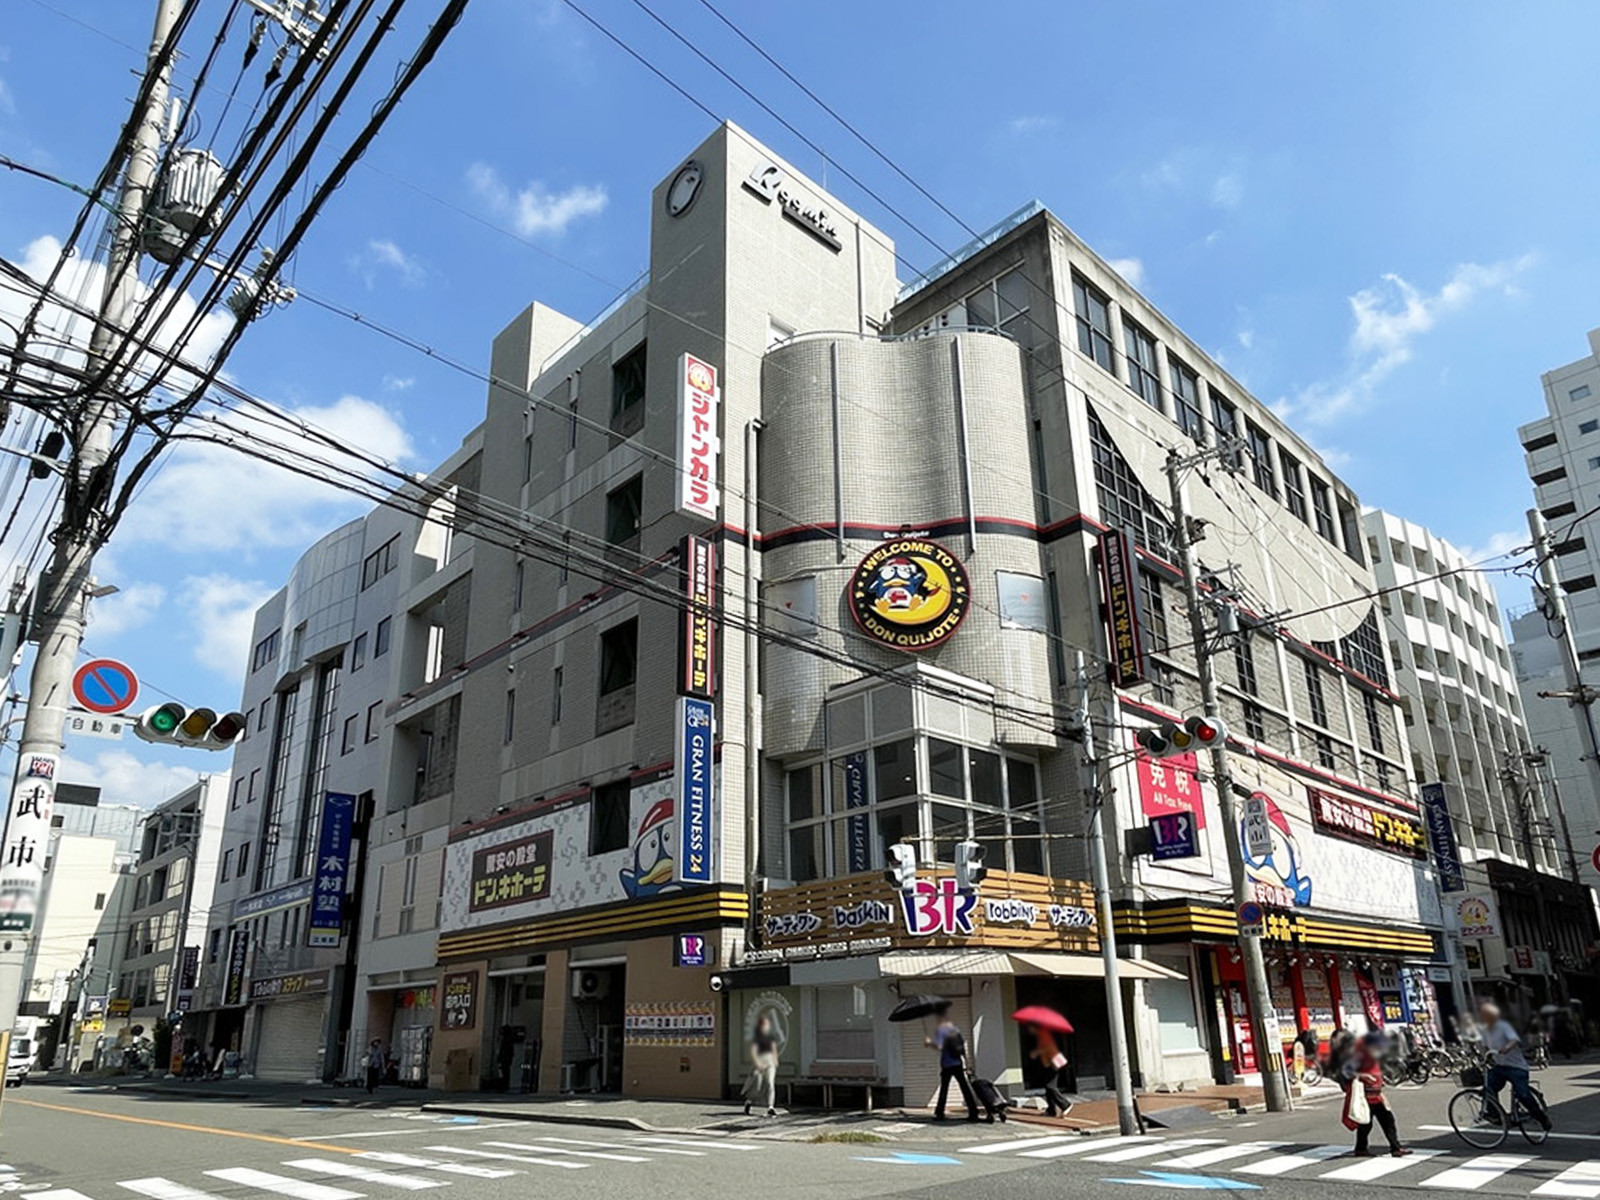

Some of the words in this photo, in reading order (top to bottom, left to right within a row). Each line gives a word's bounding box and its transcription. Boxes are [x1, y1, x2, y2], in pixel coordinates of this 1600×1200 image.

[690, 392, 709, 504] ジャンカラ
[863, 541, 935, 571] WELCOME
[935, 549, 954, 567] TO
[865, 618, 896, 642] DON
[897, 612, 960, 645] QUIJOTE
[691, 735, 704, 782] GRAN
[690, 787, 704, 852] FITNESS
[690, 853, 703, 874] 24
